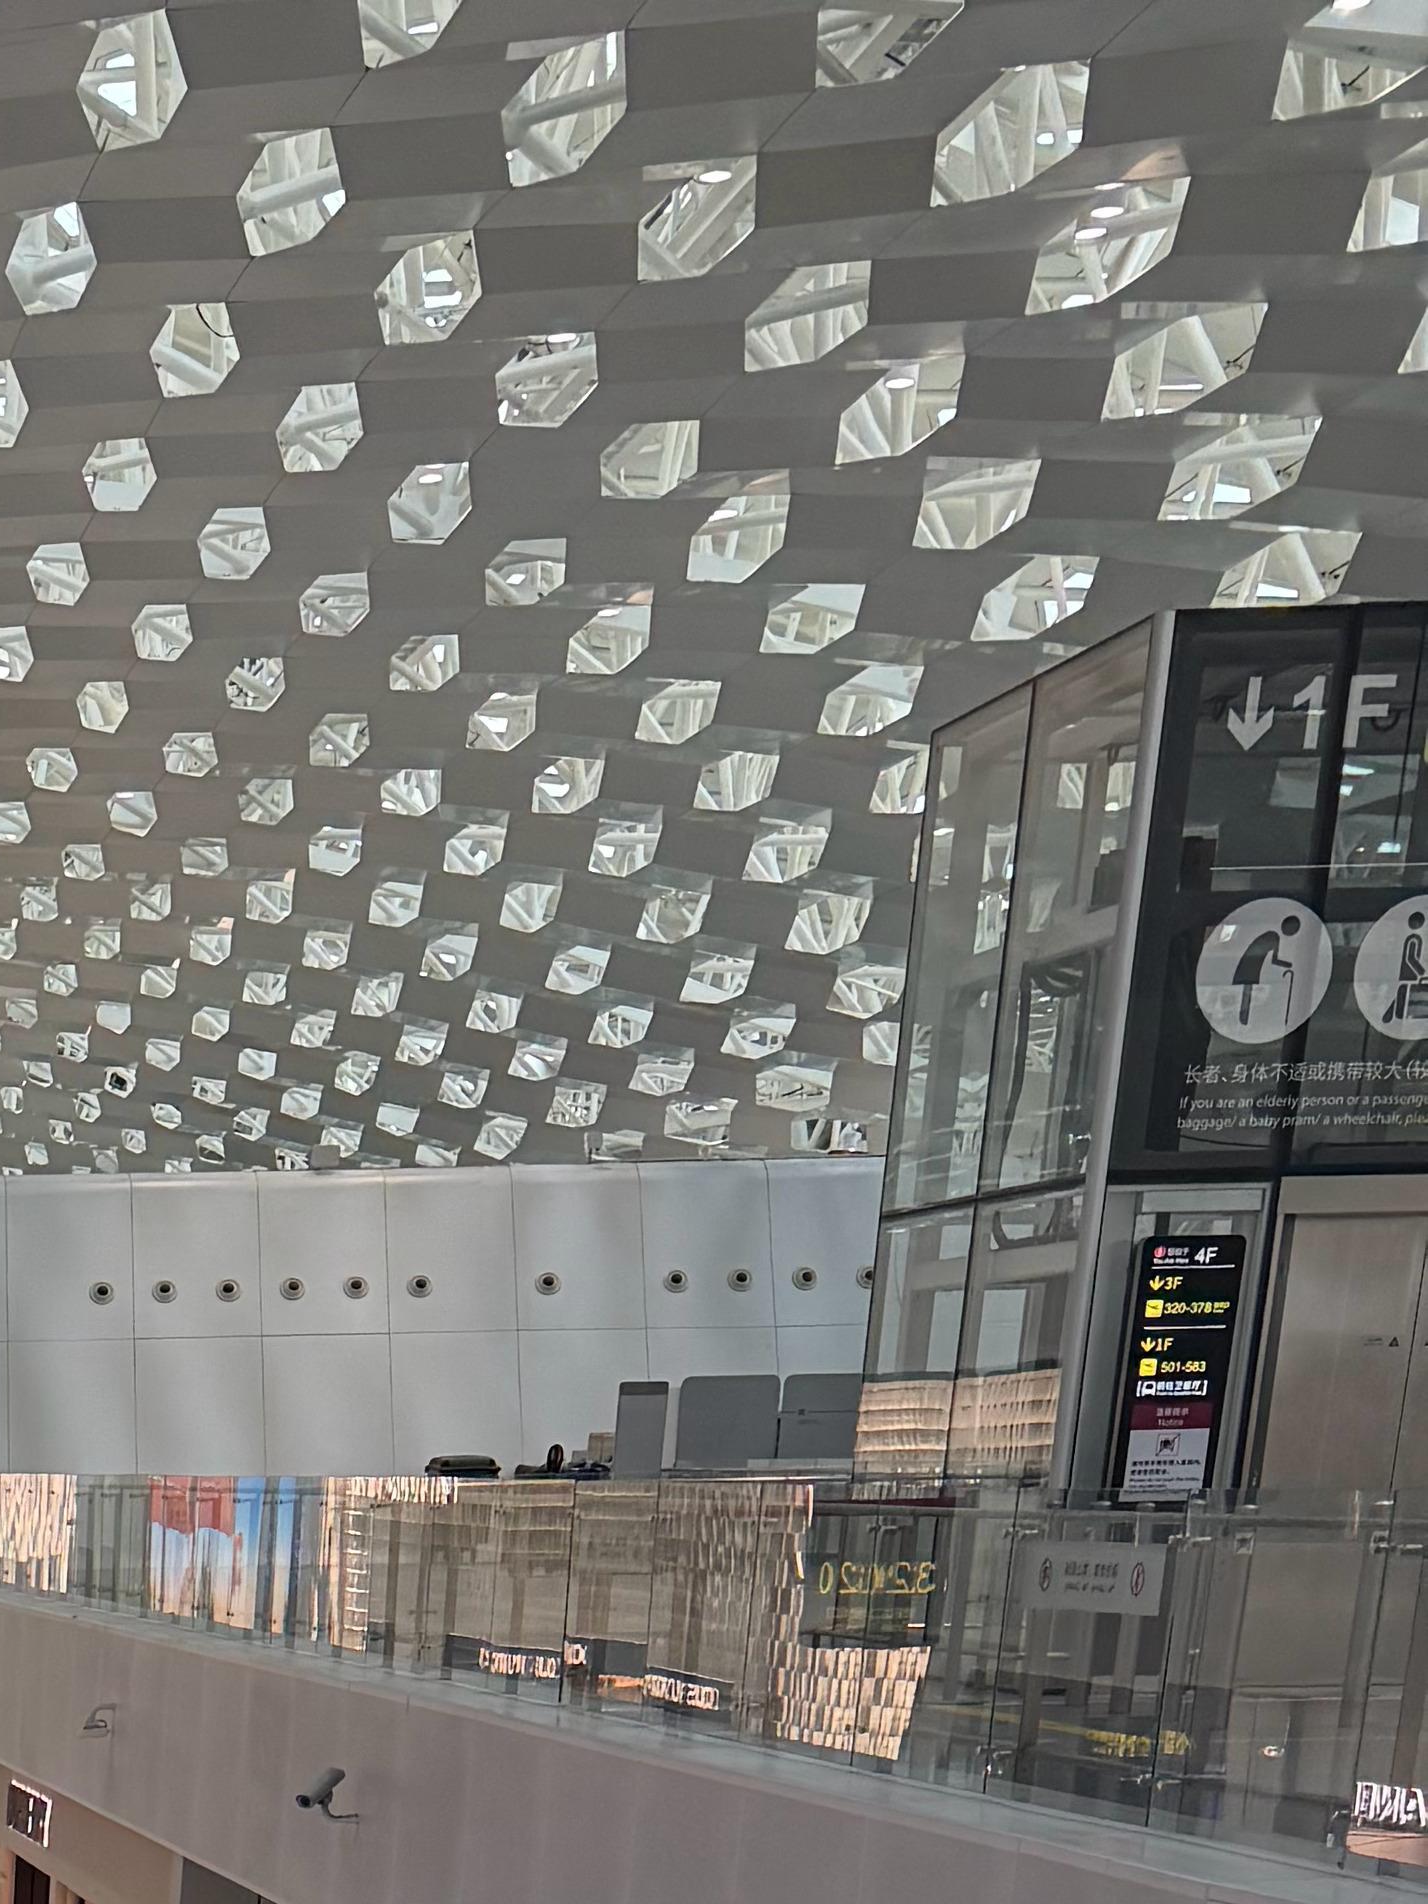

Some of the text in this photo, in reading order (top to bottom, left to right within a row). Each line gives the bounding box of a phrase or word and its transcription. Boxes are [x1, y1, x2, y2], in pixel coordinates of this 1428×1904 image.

[1293, 674, 1398, 749] 1F
[1190, 1099, 1214, 1111] you
[1216, 1100, 1235, 1109] are
[1238, 1099, 1253, 1108] an
[1256, 1095, 1296, 1109] elderly
[1301, 1097, 1344, 1111] person
[1346, 1097, 1359, 1106] or
[1249, 1113, 1280, 1129] baby
[1194, 1246, 1219, 1264] 4F
[1164, 1276, 1183, 1290] 3F
[1164, 1301, 1212, 1314] 320-378
[1156, 1337, 1174, 1352] 1F
